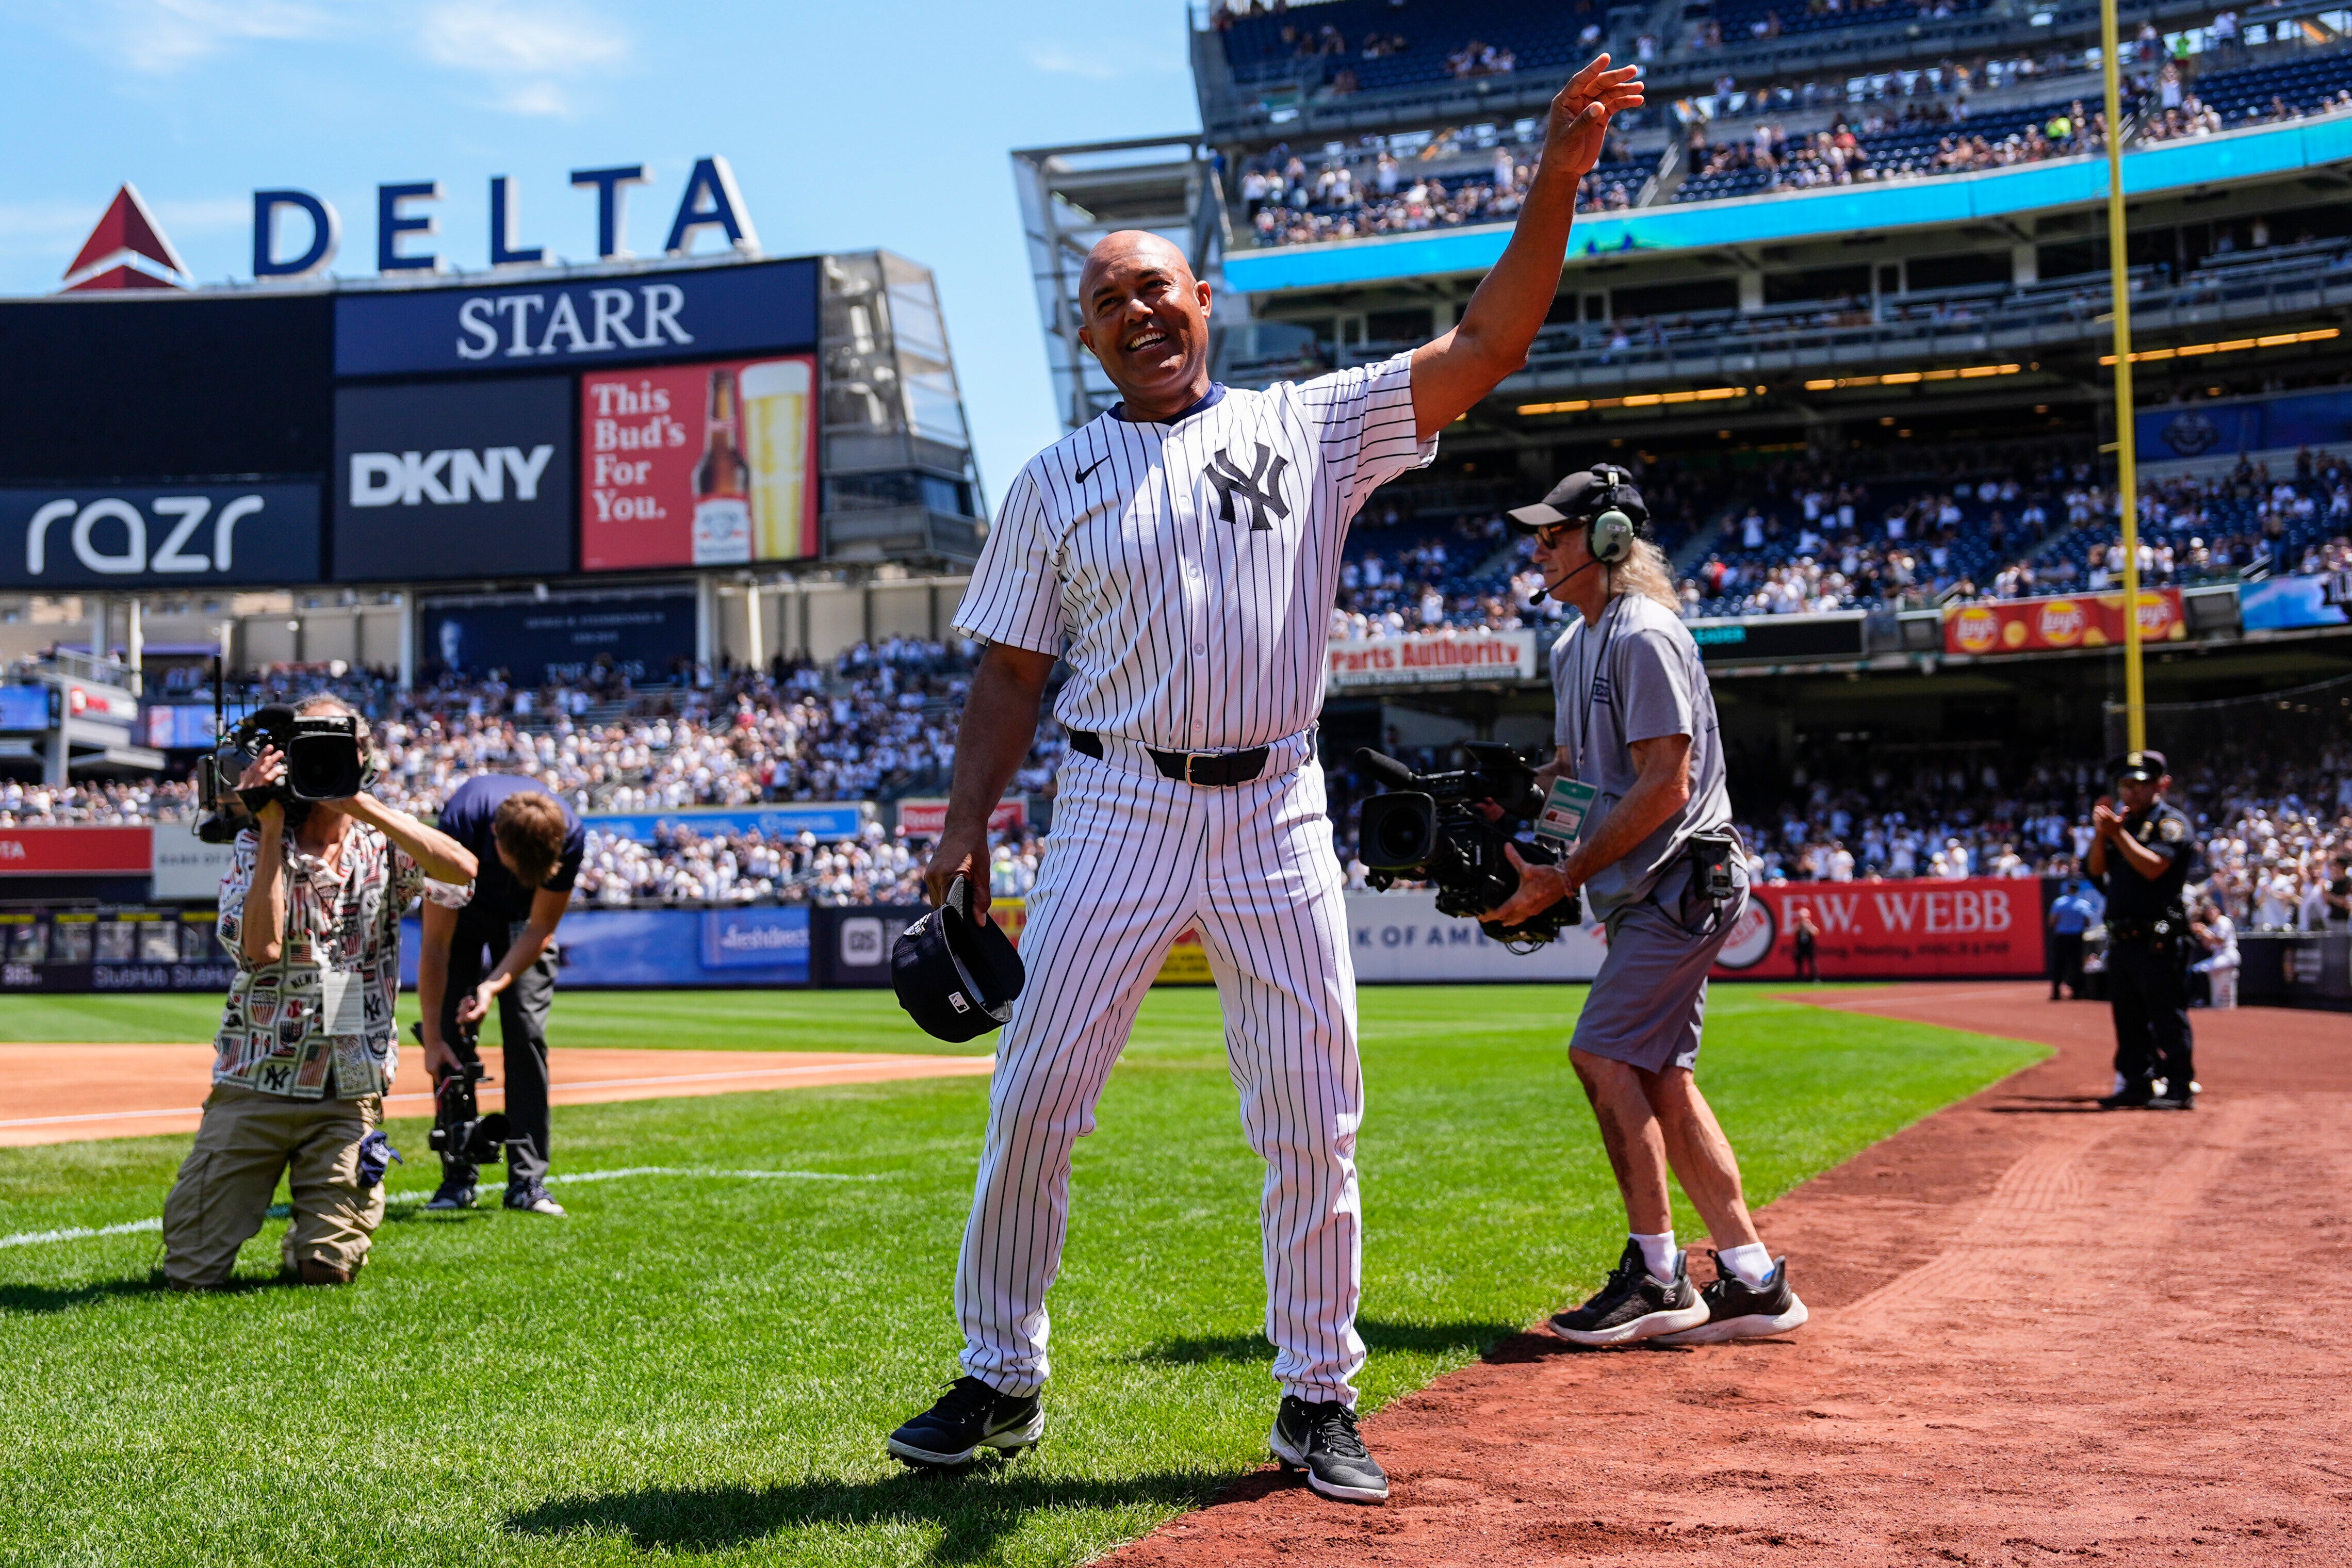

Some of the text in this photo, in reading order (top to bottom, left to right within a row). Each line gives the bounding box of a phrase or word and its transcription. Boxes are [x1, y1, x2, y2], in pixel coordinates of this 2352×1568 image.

[253, 155, 759, 277] DELTA
[456, 284, 695, 361] STARR
[591, 380, 671, 416] This
[594, 414, 687, 451] Bud's
[349, 445, 554, 508] DKNY
[594, 453, 652, 486] For
[1202, 442, 1291, 531] NY
[592, 488, 667, 522] You.
[26, 494, 265, 575] razr
[1331, 638, 1519, 671] Parts Authority
[1872, 889, 2012, 934] WEBB
[1381, 926, 1417, 949] OF
